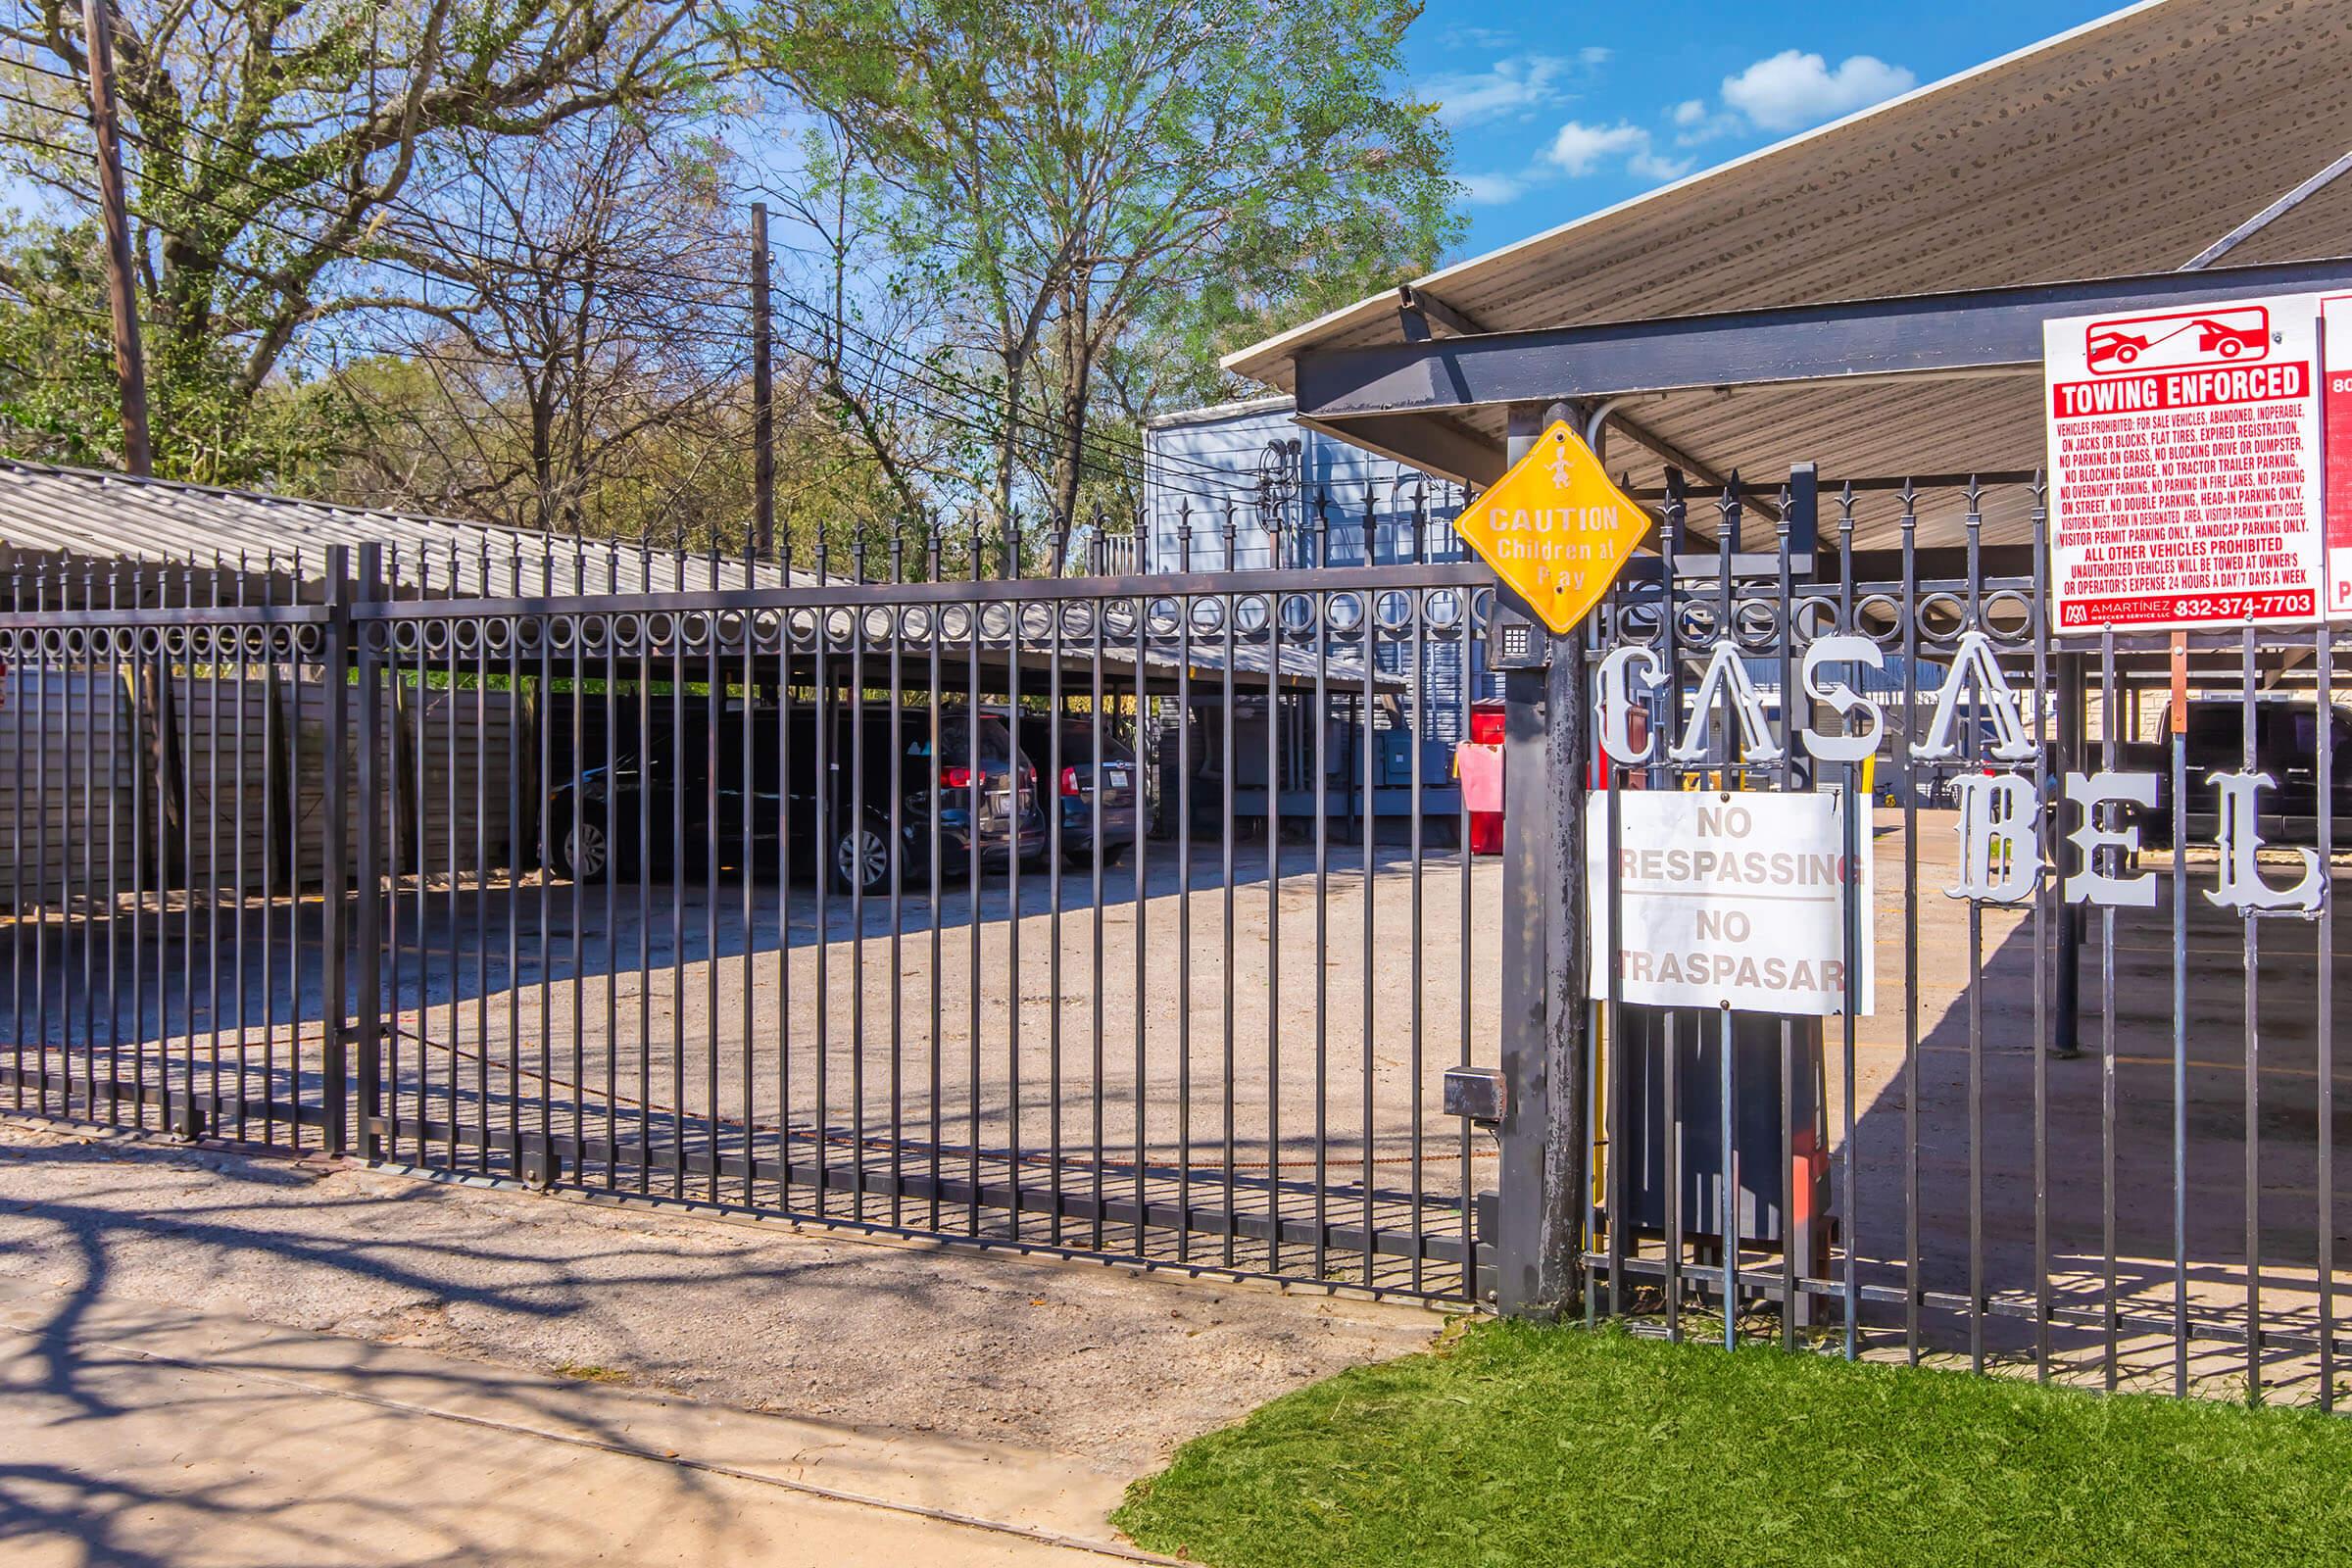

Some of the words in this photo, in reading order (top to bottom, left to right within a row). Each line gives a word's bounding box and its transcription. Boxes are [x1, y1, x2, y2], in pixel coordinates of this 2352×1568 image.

[2061, 378, 2158, 415] TOWING
[2167, 366, 2300, 406] ENFORCED
[2057, 421, 2089, 437] VEHICLES
[2091, 418, 2134, 434] PROHIBITED:
[2137, 416, 2151, 430] FOR
[2152, 415, 2170, 429] SALE
[2062, 438, 2073, 452] ON
[2076, 436, 2100, 451] JACKS
[2102, 435, 2114, 450] OR
[2151, 431, 2170, 446] FLAT
[2200, 425, 2234, 441] EXPIRED
[2059, 455, 2070, 468] NO
[2073, 452, 2107, 467] PARKING
[2110, 451, 2121, 465] ON
[2154, 447, 2166, 461] NO
[2169, 444, 2209, 460] BLOCKING
[2212, 441, 2237, 457] DRIVE
[2240, 440, 2251, 455] OR
[2065, 469, 2077, 483] NO
[2079, 466, 2121, 482] BLOCKING
[2162, 463, 2174, 476] NO
[2177, 460, 2216, 475] TRACTOR
[2218, 457, 2254, 471] TRAILER
[2060, 486, 2071, 500] NO
[2073, 483, 2114, 499] OVERNIGHT
[2152, 479, 2163, 493] NO
[2165, 476, 2197, 492] PARKING
[2199, 476, 2207, 490] IN
[2210, 474, 2227, 489] FIRE
[2257, 471, 2268, 485] NO
[2271, 468, 2305, 484] PARKING
[2061, 502, 2073, 515] ON
[2110, 498, 2122, 512] NO
[2124, 496, 2156, 512] DOUBLE
[2200, 491, 2236, 507] HEAD-IN
[2238, 488, 2277, 504] PARKING
[1489, 506, 1619, 533] CAUTION
[2061, 516, 2090, 531] VISITORS
[2092, 514, 2110, 529] MUST
[2112, 514, 2130, 527] PARK
[2132, 514, 2138, 526] IN
[2139, 511, 2180, 526] DESIGNATED
[2205, 507, 2232, 521] VISITOR
[2233, 505, 2263, 519] PARKING
[2265, 504, 2283, 518] WITH
[2059, 532, 2092, 547] VISITOR
[2094, 530, 2127, 545] PERMIT
[2129, 527, 2166, 542] PARKING
[2195, 522, 2239, 538] HANDICAP
[2242, 519, 2280, 535] PARKING
[1496, 538, 1592, 561] Children
[1599, 538, 1615, 560] at
[2084, 547, 2105, 562] ALL
[2108, 545, 2146, 561] OTHER
[2149, 541, 2207, 559] VEHICLES
[2210, 537, 2282, 555] PROHIBITED
[1538, 565, 1585, 590] Pay
[2071, 562, 2132, 579] UNAUTHORIZED
[2135, 560, 2175, 575] VEHICLES
[2178, 558, 2197, 573] WILL
[2200, 558, 2211, 572] BE
[2213, 556, 2242, 571] TOWED
[2245, 555, 2257, 568] AT
[2064, 581, 2076, 596] OR
[2130, 576, 2166, 592] EXPENSE
[2169, 575, 2179, 590] 24
[2181, 574, 2210, 589] HOURS
[2249, 570, 2271, 585] DAYS
[2281, 569, 2306, 584] WEEK
[2176, 595, 2311, 617] 832-374-7703
[1594, 632, 2040, 763] CASA
[1696, 807, 1752, 839] NO
[1941, 771, 2328, 912] BEL
[1618, 848, 1865, 886] RESPASSING
[1695, 909, 1751, 944] NO
[1617, 950, 1845, 992] TRASPASAR
